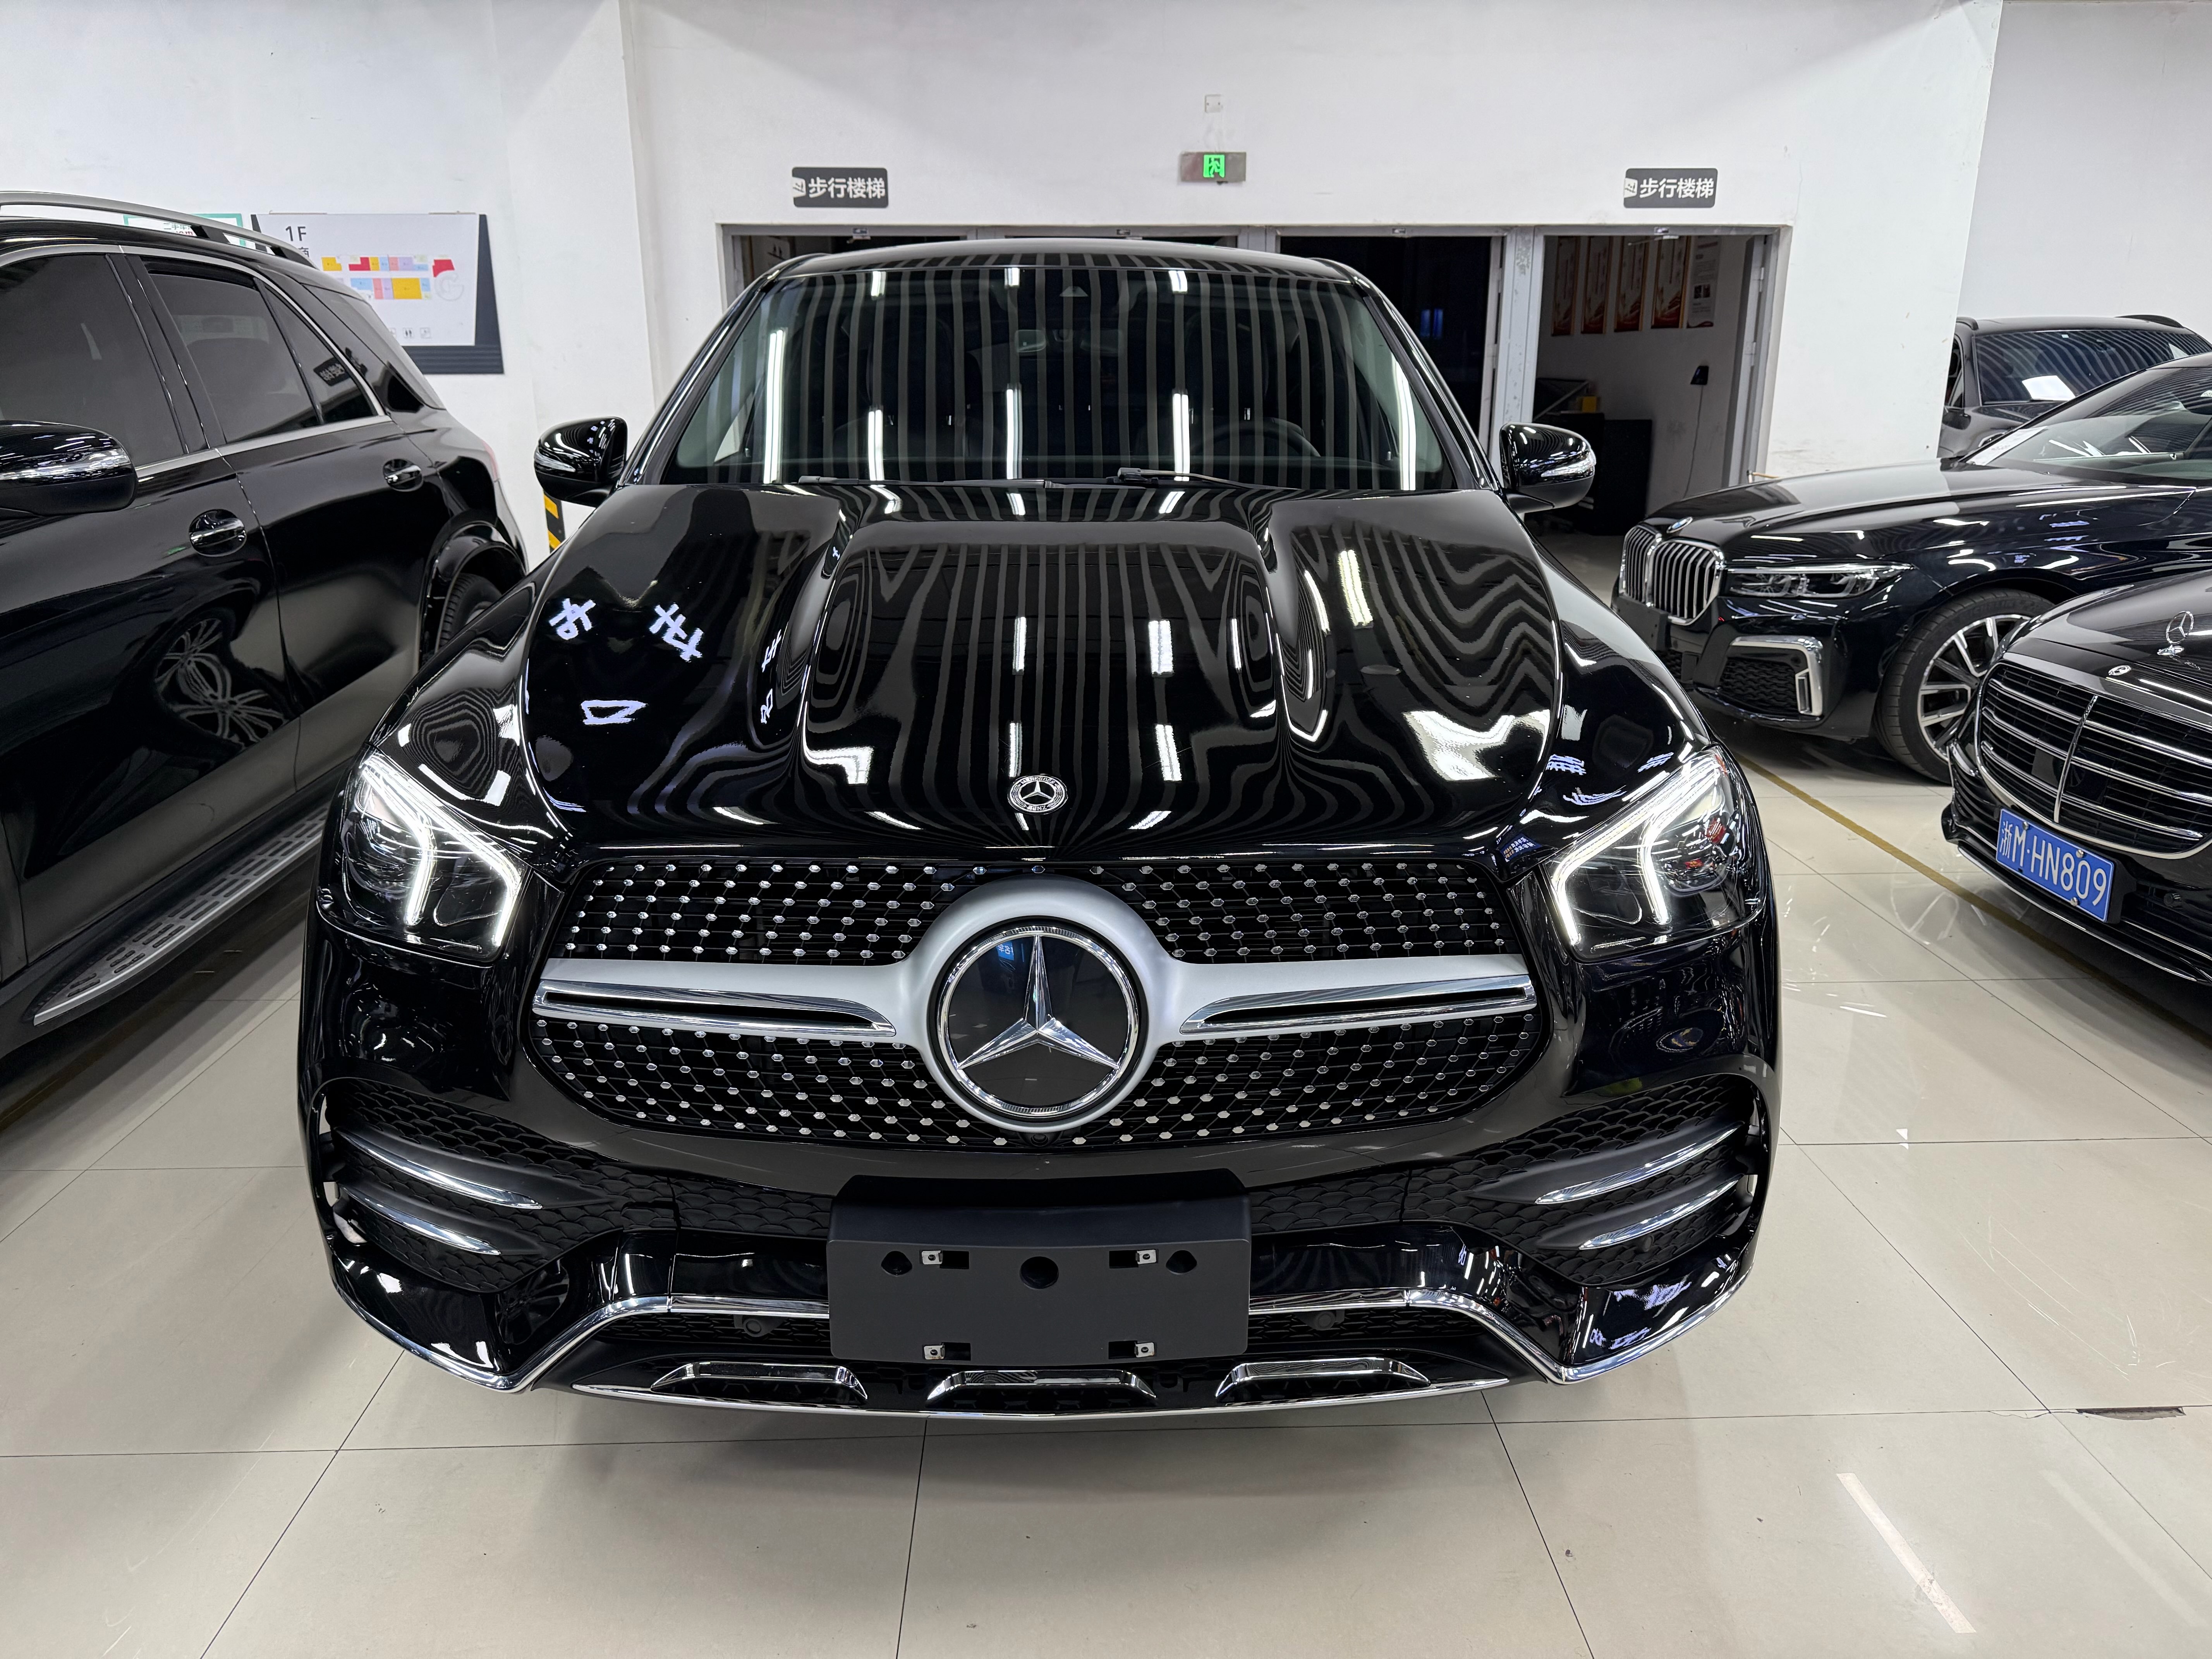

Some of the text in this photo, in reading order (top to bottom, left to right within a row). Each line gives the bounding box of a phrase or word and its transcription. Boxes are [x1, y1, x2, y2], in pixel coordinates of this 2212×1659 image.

[809, 177, 886, 199] 步行楼梯
[1639, 178, 1714, 199] 步行楼梯
[285, 226, 306, 242] 1F
